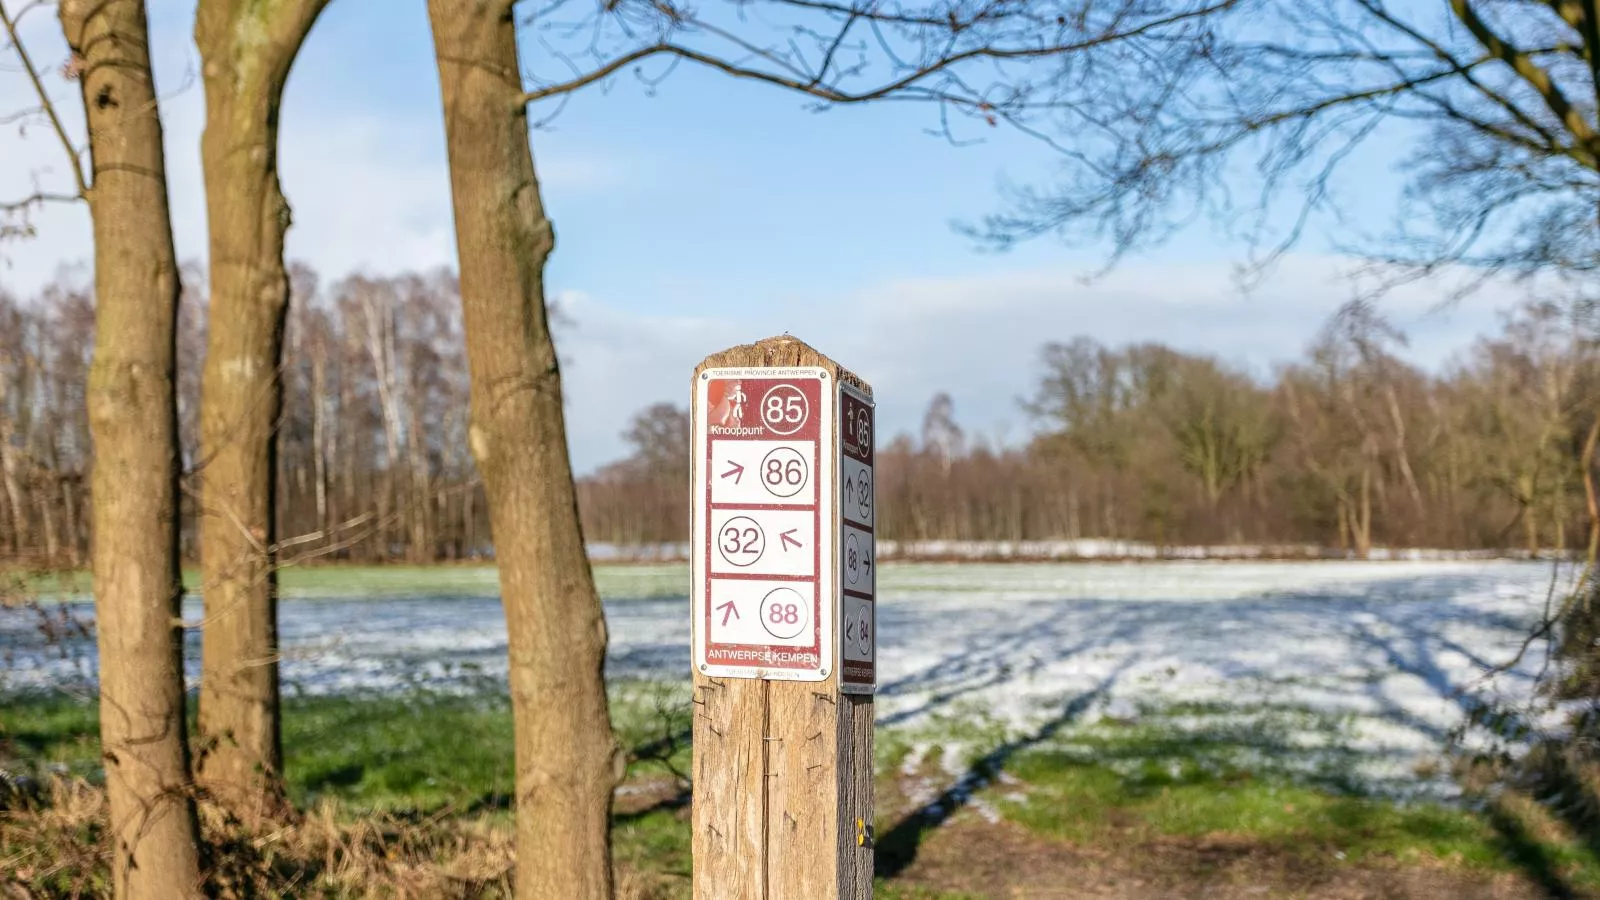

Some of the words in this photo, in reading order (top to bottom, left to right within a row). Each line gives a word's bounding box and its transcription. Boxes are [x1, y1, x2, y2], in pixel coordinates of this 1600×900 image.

[766, 396, 803, 423] 85
[711, 425, 764, 436] Knooppunt
[858, 419, 869, 447] 85
[766, 459, 802, 486] 86
[858, 480, 869, 507] 32
[723, 527, 759, 554] 32
[848, 548, 857, 571] 88
[769, 603, 799, 624] 88
[707, 650, 771, 661] ANTWERPSE
[773, 652, 818, 663] KEMPEN
